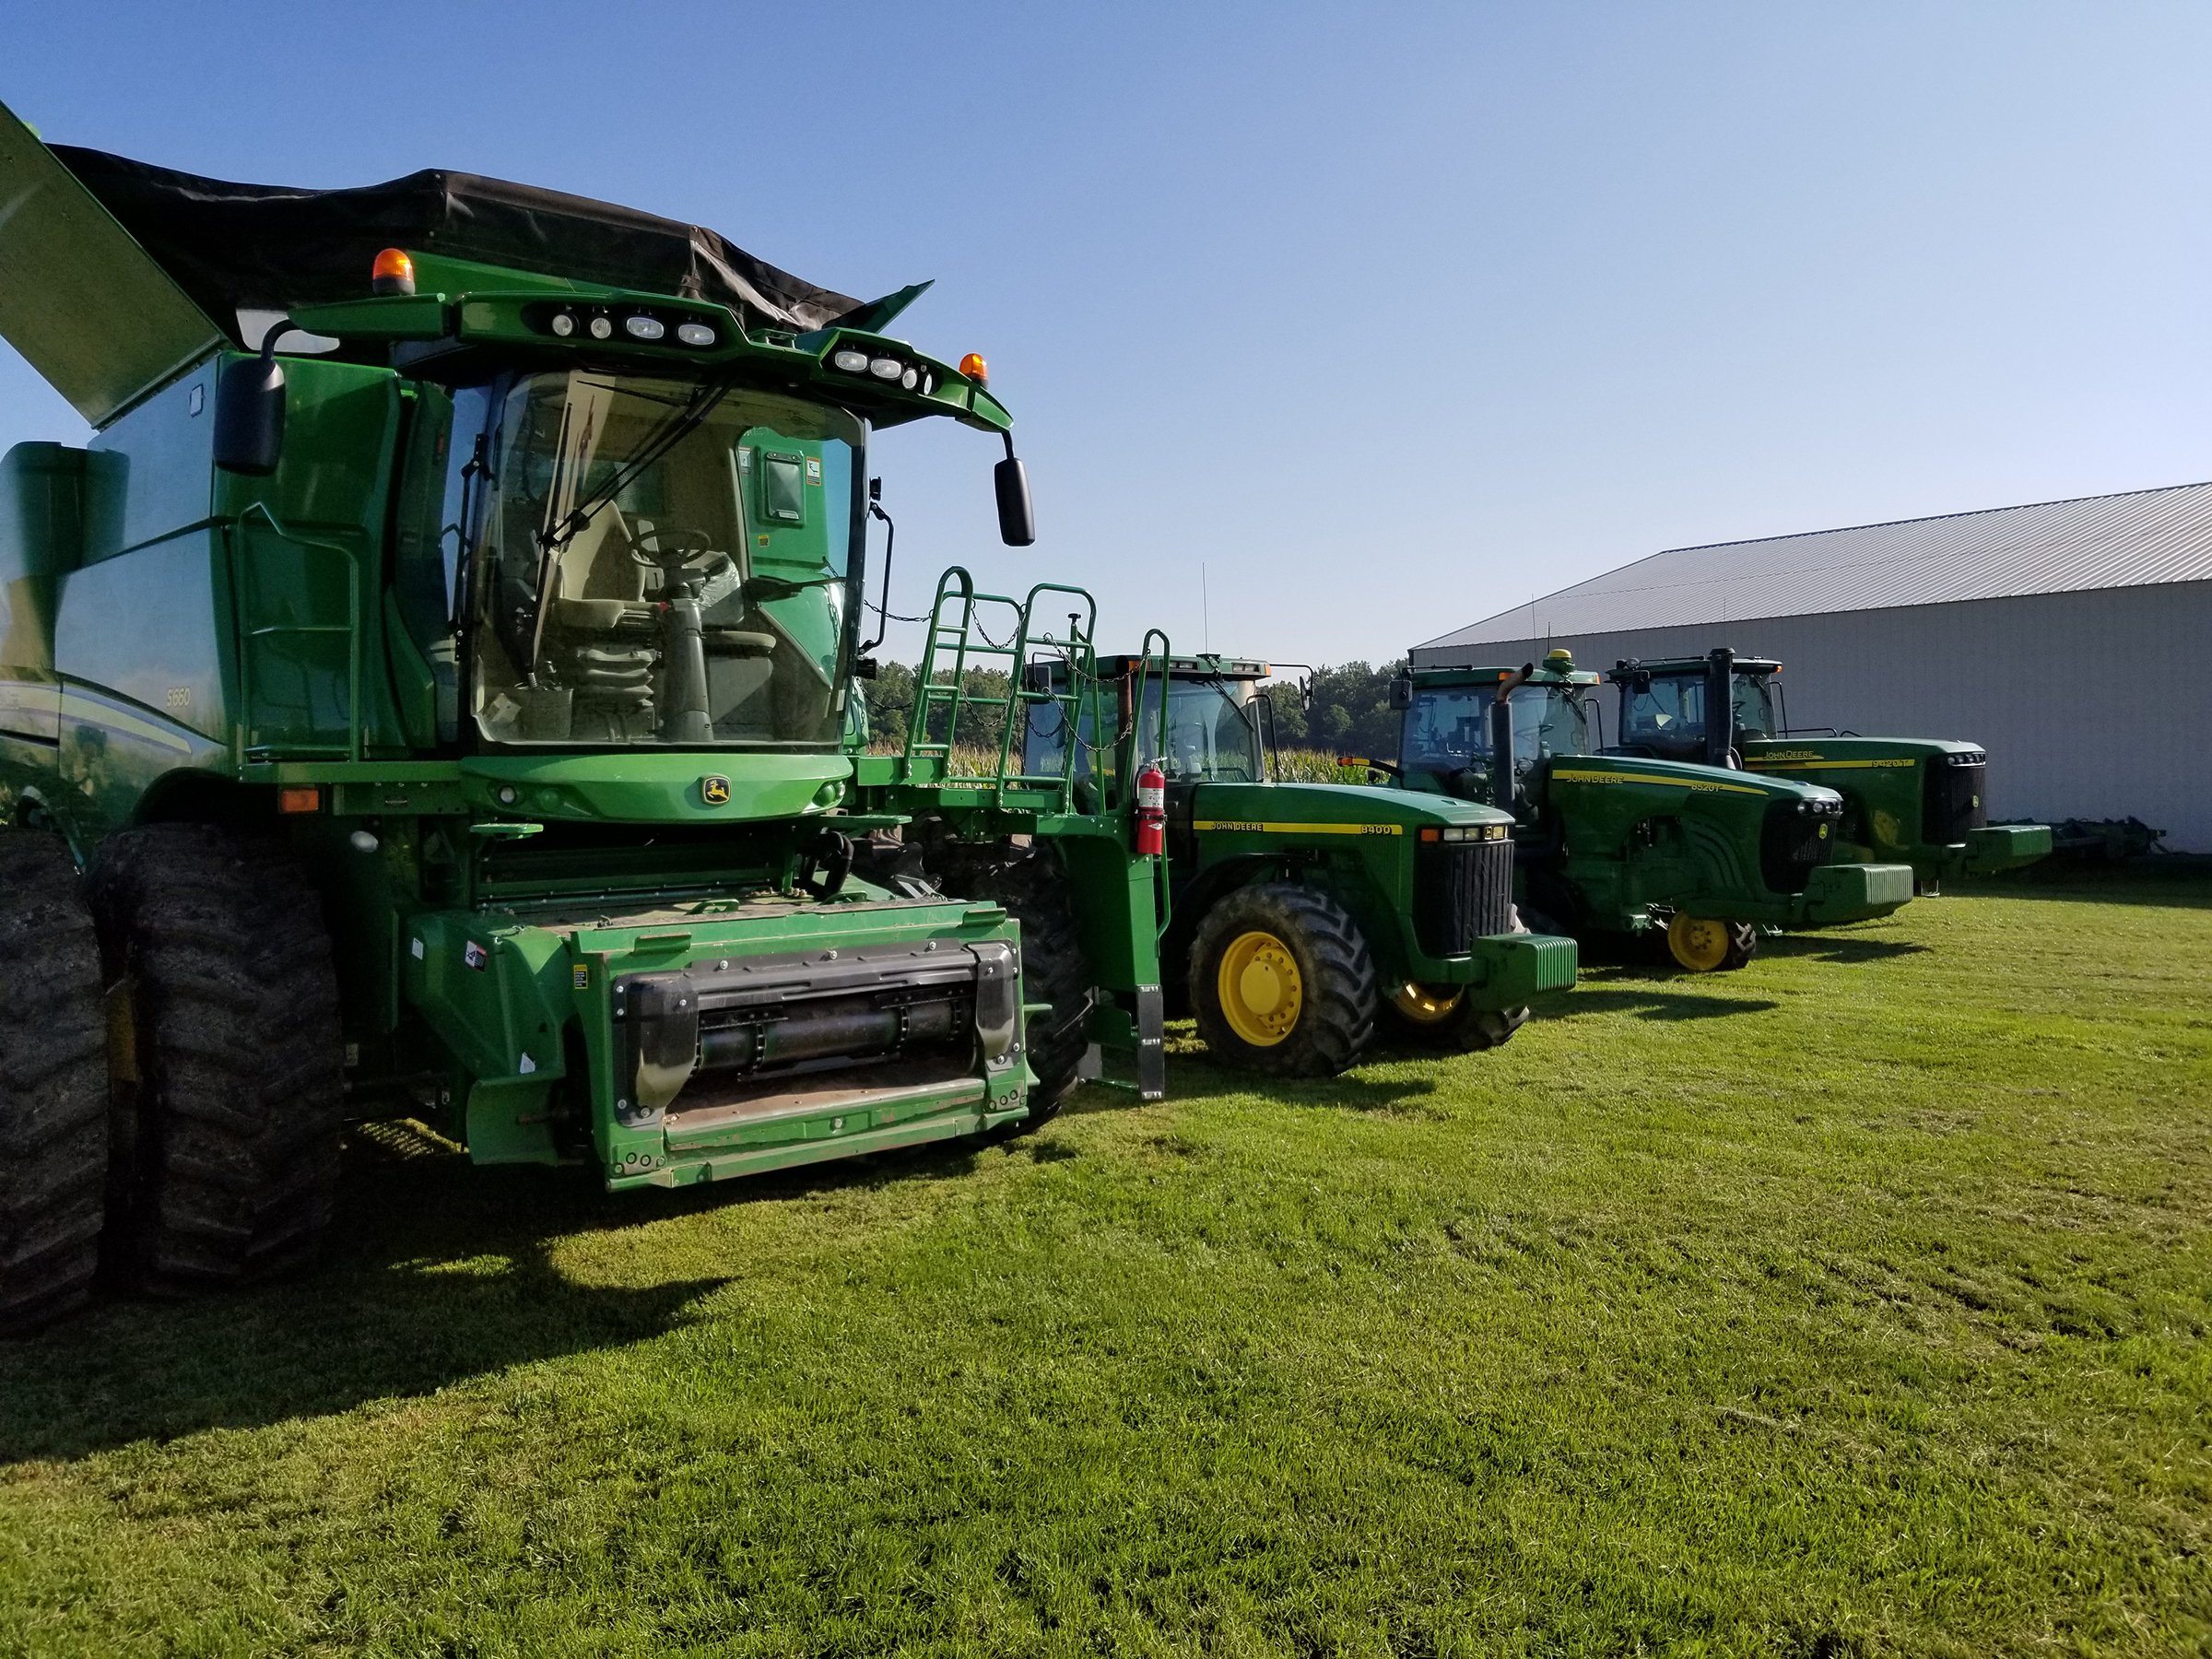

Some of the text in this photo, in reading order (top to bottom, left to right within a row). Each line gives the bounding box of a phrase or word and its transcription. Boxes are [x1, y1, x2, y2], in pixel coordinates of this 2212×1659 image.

[167, 687, 191, 707] S660
[1786, 750, 1814, 759] DEERE
[1592, 775, 1623, 784] DEERE
[1691, 783, 1720, 793] 8520T
[1211, 821, 1263, 831] JOHN DEERE
[1361, 825, 1391, 834] 8400
